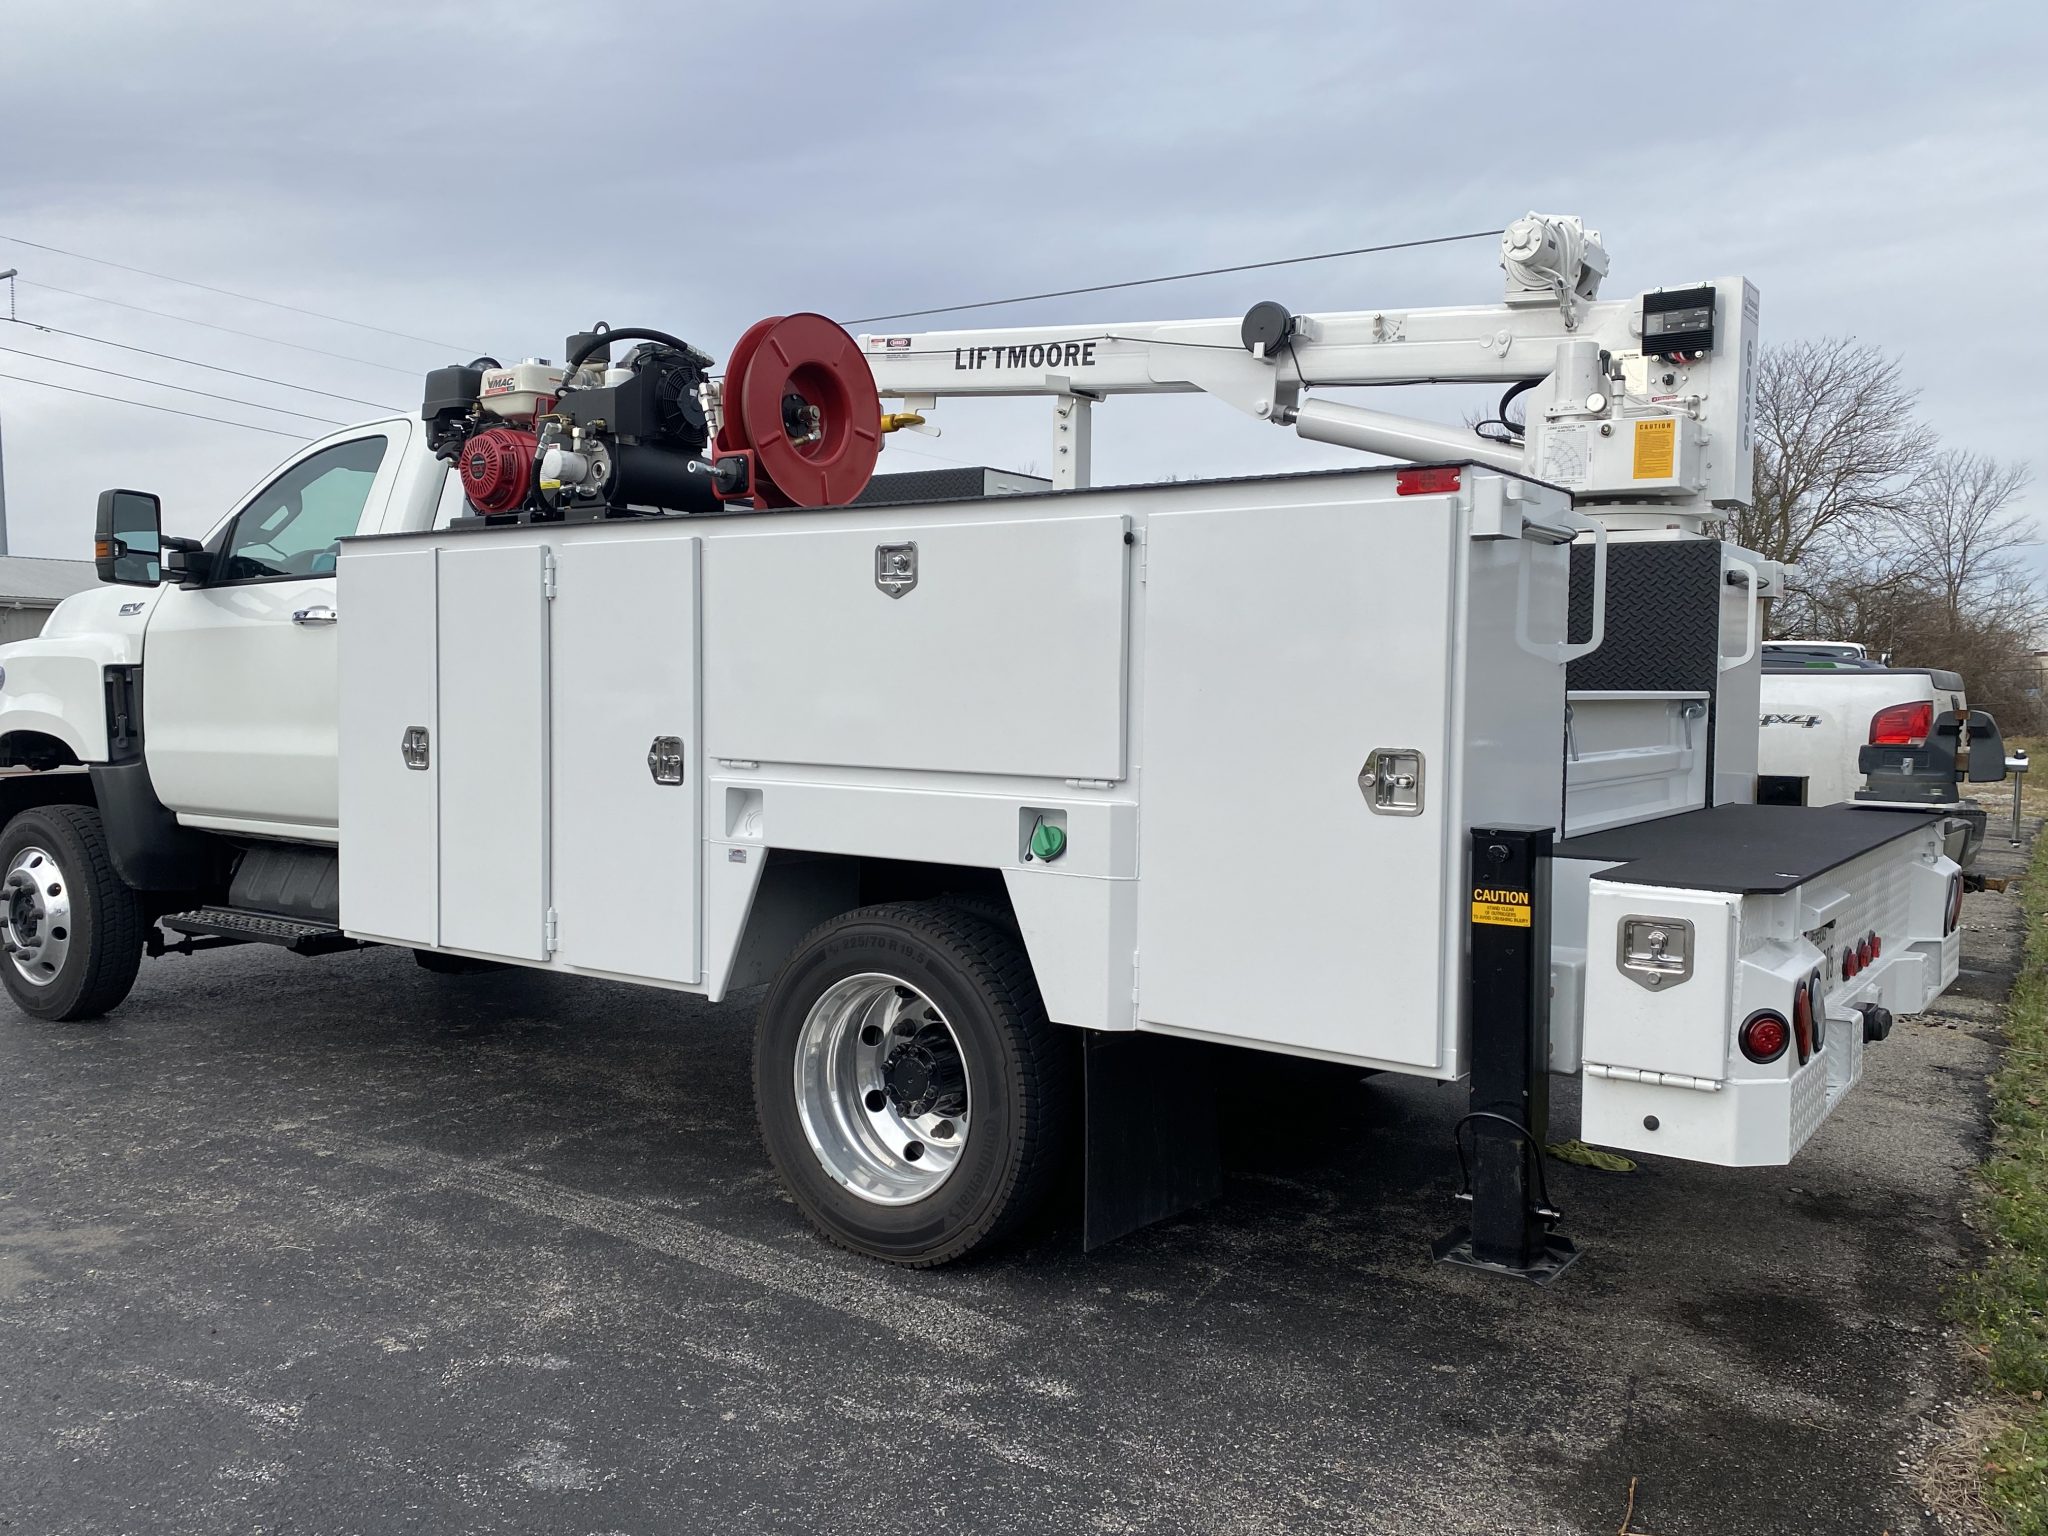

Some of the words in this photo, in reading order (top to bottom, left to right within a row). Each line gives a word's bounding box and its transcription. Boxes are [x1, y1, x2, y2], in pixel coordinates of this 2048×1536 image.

[955, 342, 1097, 370] LIFTMOORE
[487, 377, 515, 389] VMAC
[1639, 422, 1671, 430] CAUTION
[1474, 888, 1529, 904] CAUTION
